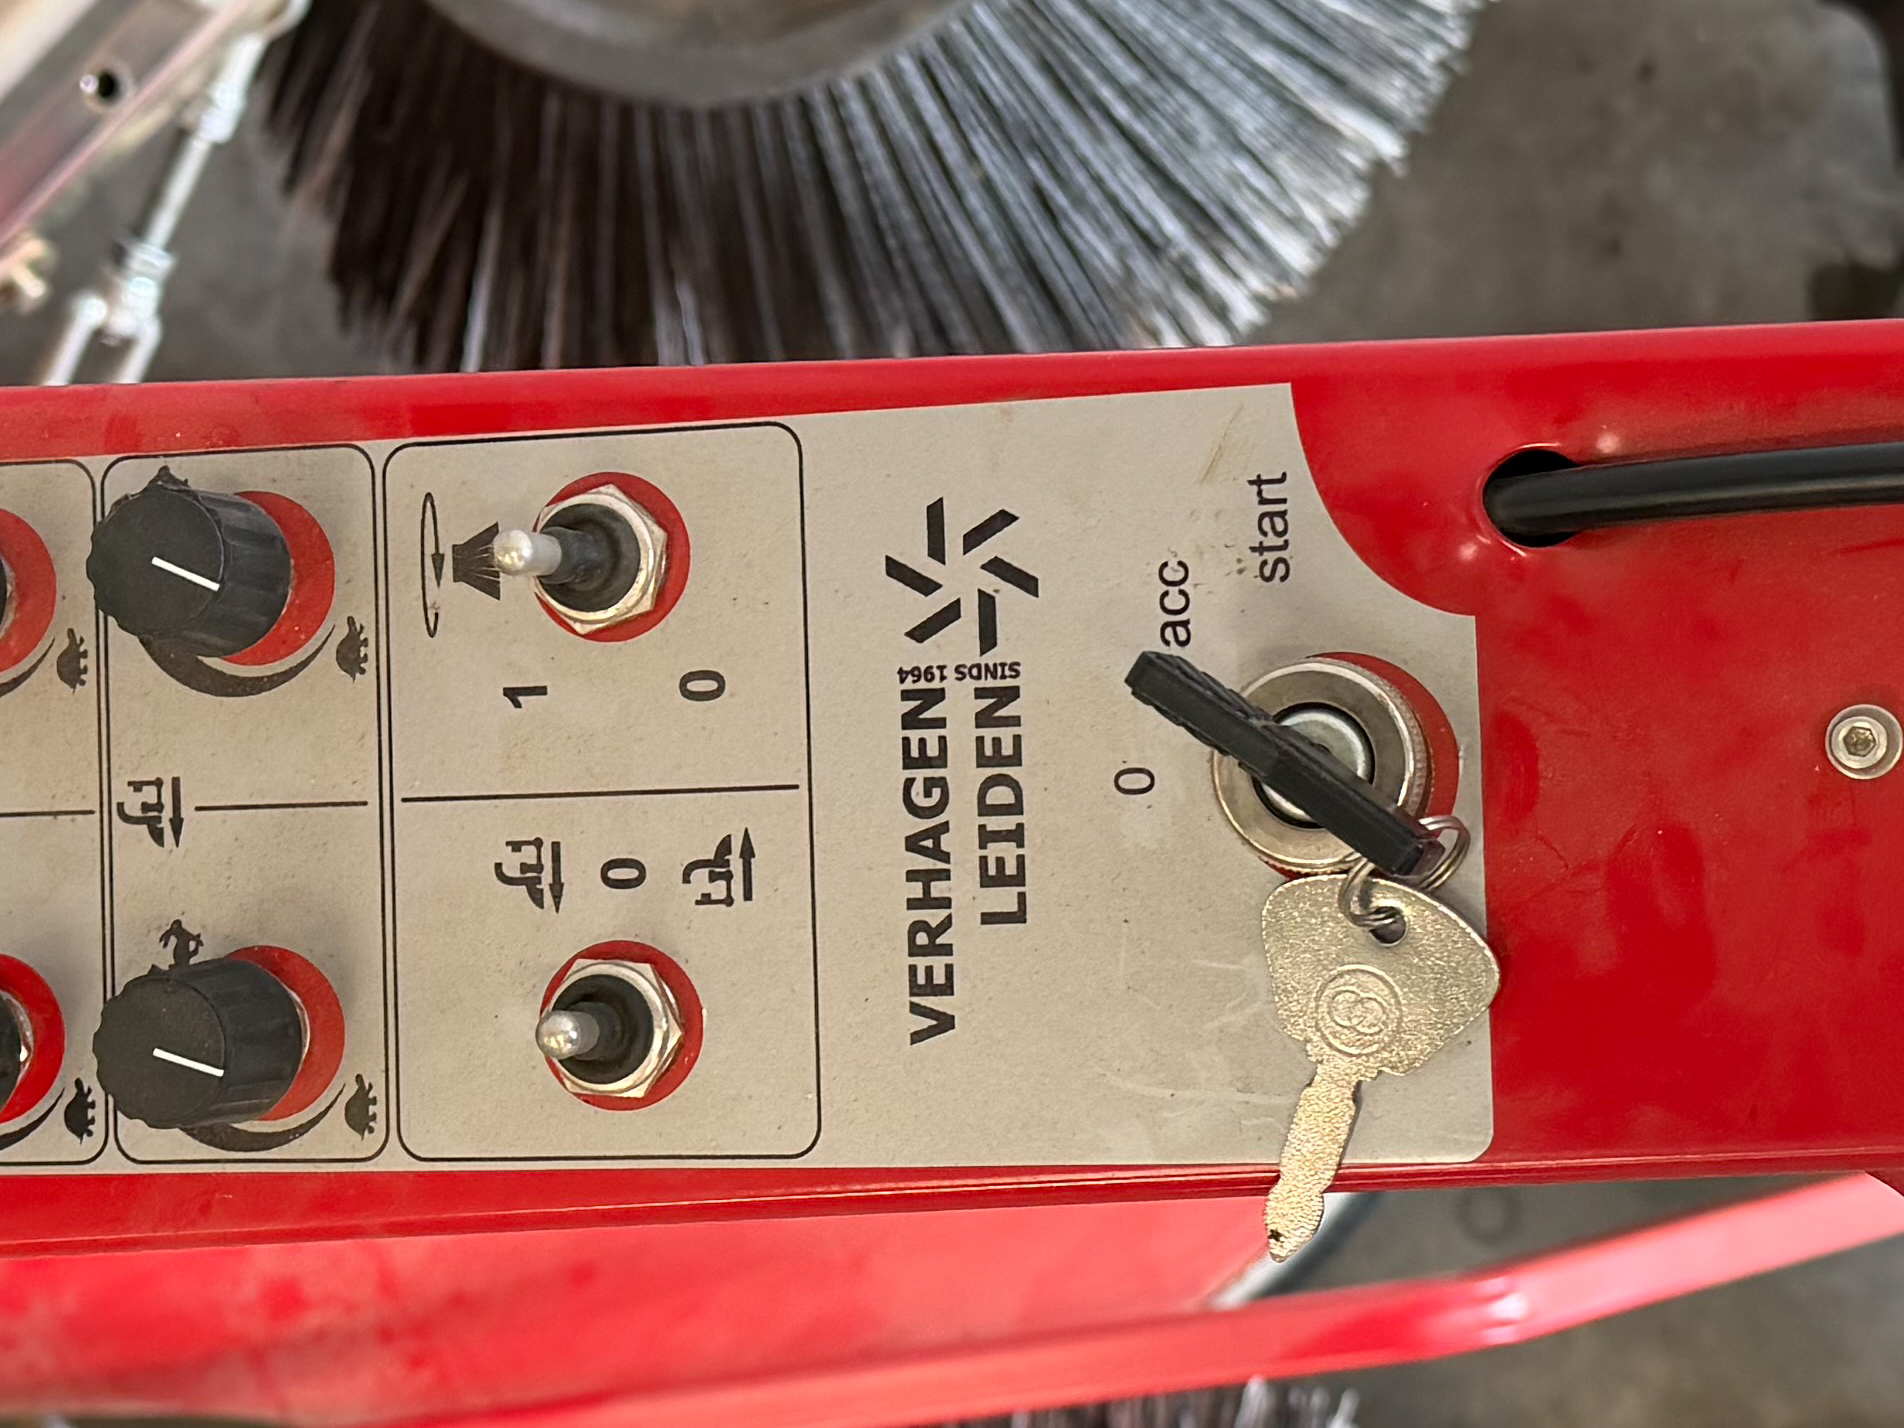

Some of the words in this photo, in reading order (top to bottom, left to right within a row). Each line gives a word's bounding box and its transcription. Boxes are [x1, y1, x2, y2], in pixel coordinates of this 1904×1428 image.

[1247, 471, 1291, 584] start
[1158, 559, 1192, 648] acc
[679, 669, 726, 702] 0
[896, 664, 948, 685] 1964
[954, 661, 1022, 682] SINDS
[502, 685, 548, 709] 1
[1113, 766, 1156, 796] 0
[973, 685, 1027, 926] LEIDEN
[599, 857, 647, 890] 0
[900, 687, 956, 1046] VERHAGEN
